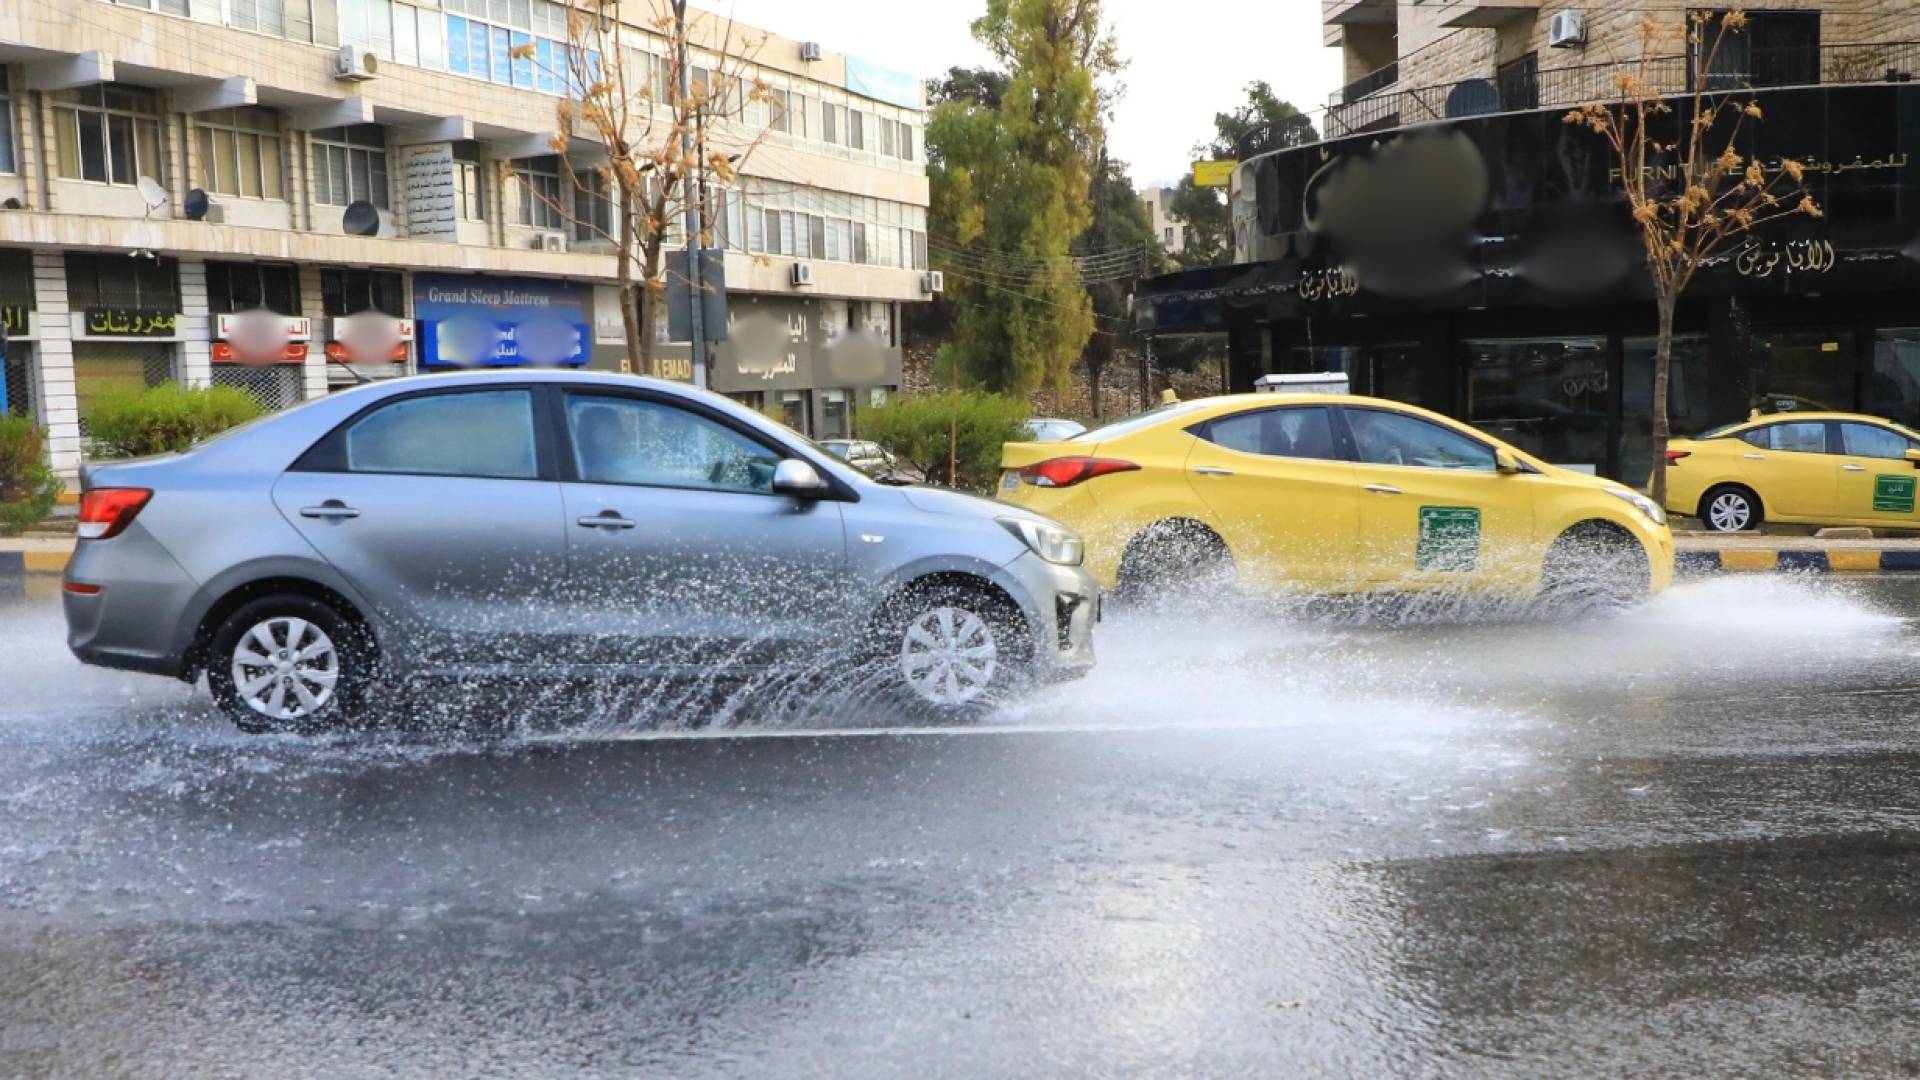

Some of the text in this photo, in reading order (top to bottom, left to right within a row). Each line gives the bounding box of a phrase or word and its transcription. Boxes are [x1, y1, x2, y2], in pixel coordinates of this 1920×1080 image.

[1762, 153, 1907, 174] للمفروشت
[429, 286, 550, 306] Grand Sleep Mattress
[90, 311, 176, 332] مفروشات
[662, 359, 691, 379] EMAD
